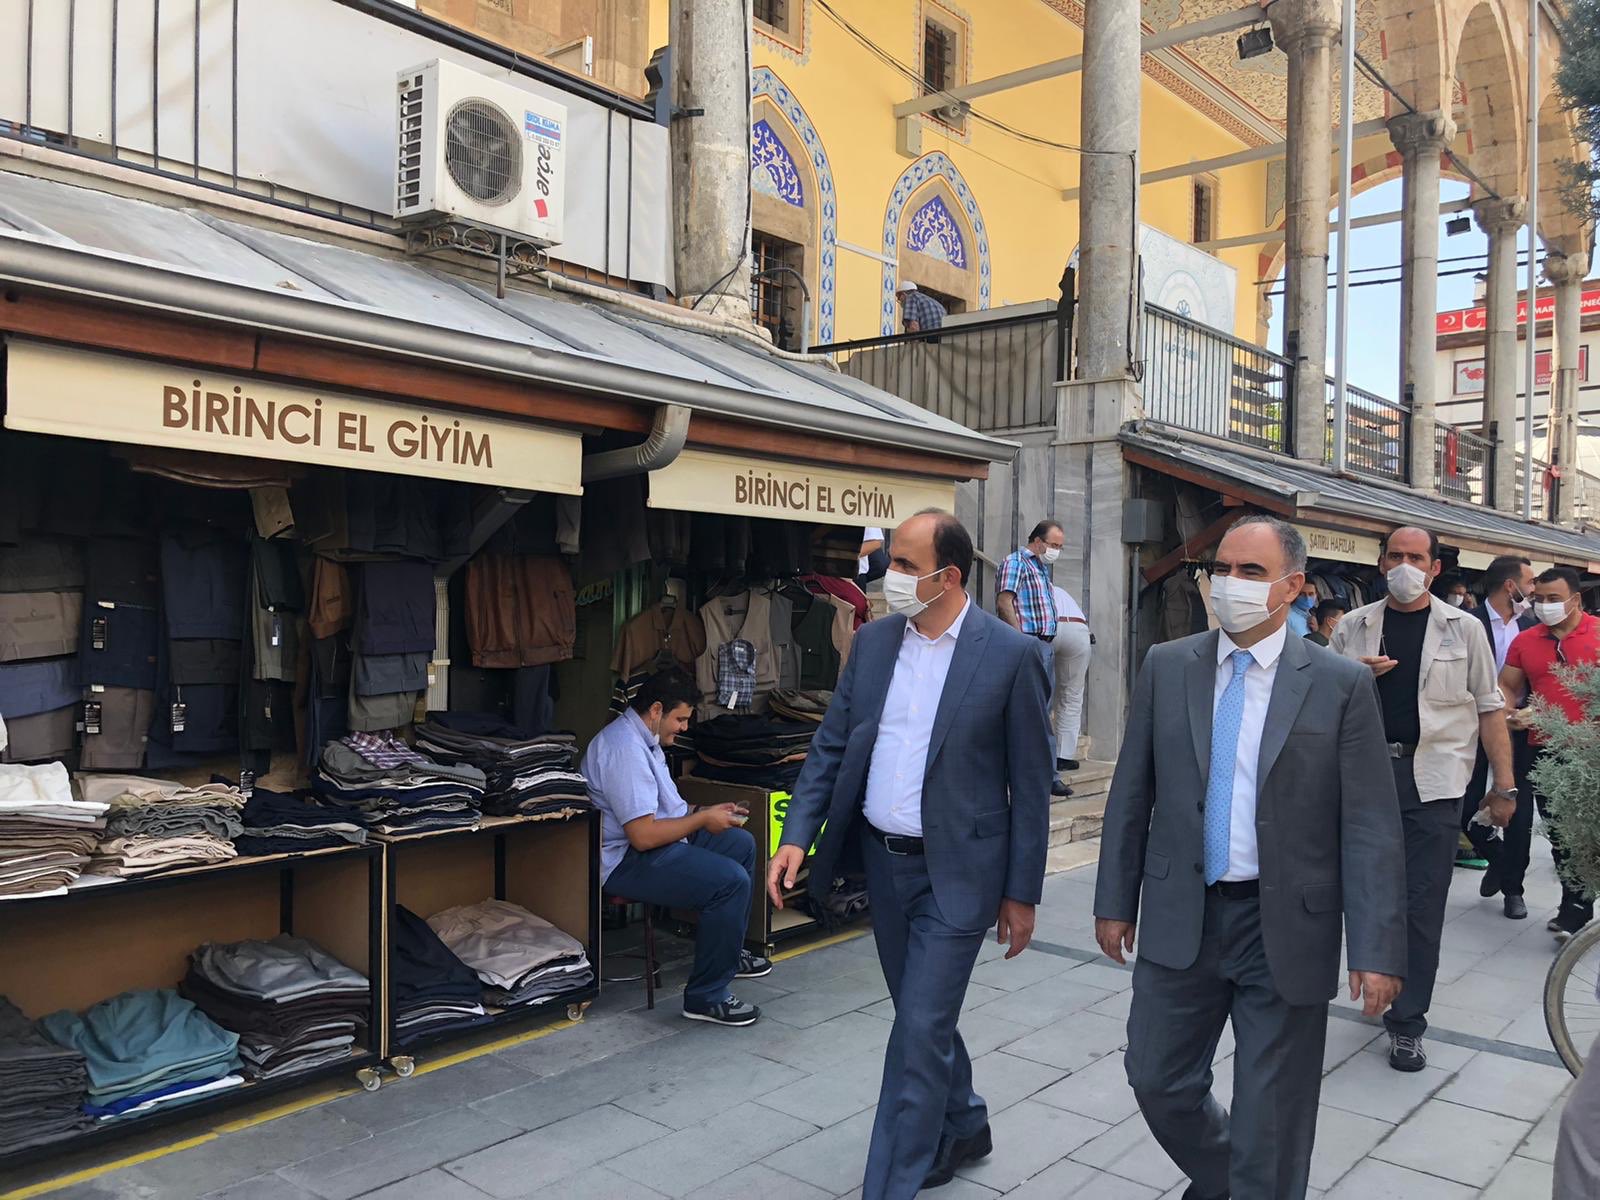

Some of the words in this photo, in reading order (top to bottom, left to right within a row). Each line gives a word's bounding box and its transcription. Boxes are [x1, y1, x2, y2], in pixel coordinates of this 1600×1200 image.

[536, 144, 554, 197] arçe
[162, 379, 322, 446] BİRİNCİ
[337, 411, 375, 453] EL
[387, 415, 493, 468] GİYİM
[735, 469, 810, 511] BİRİNCİ
[816, 485, 835, 513] EL
[841, 484, 895, 519] GİYİM
